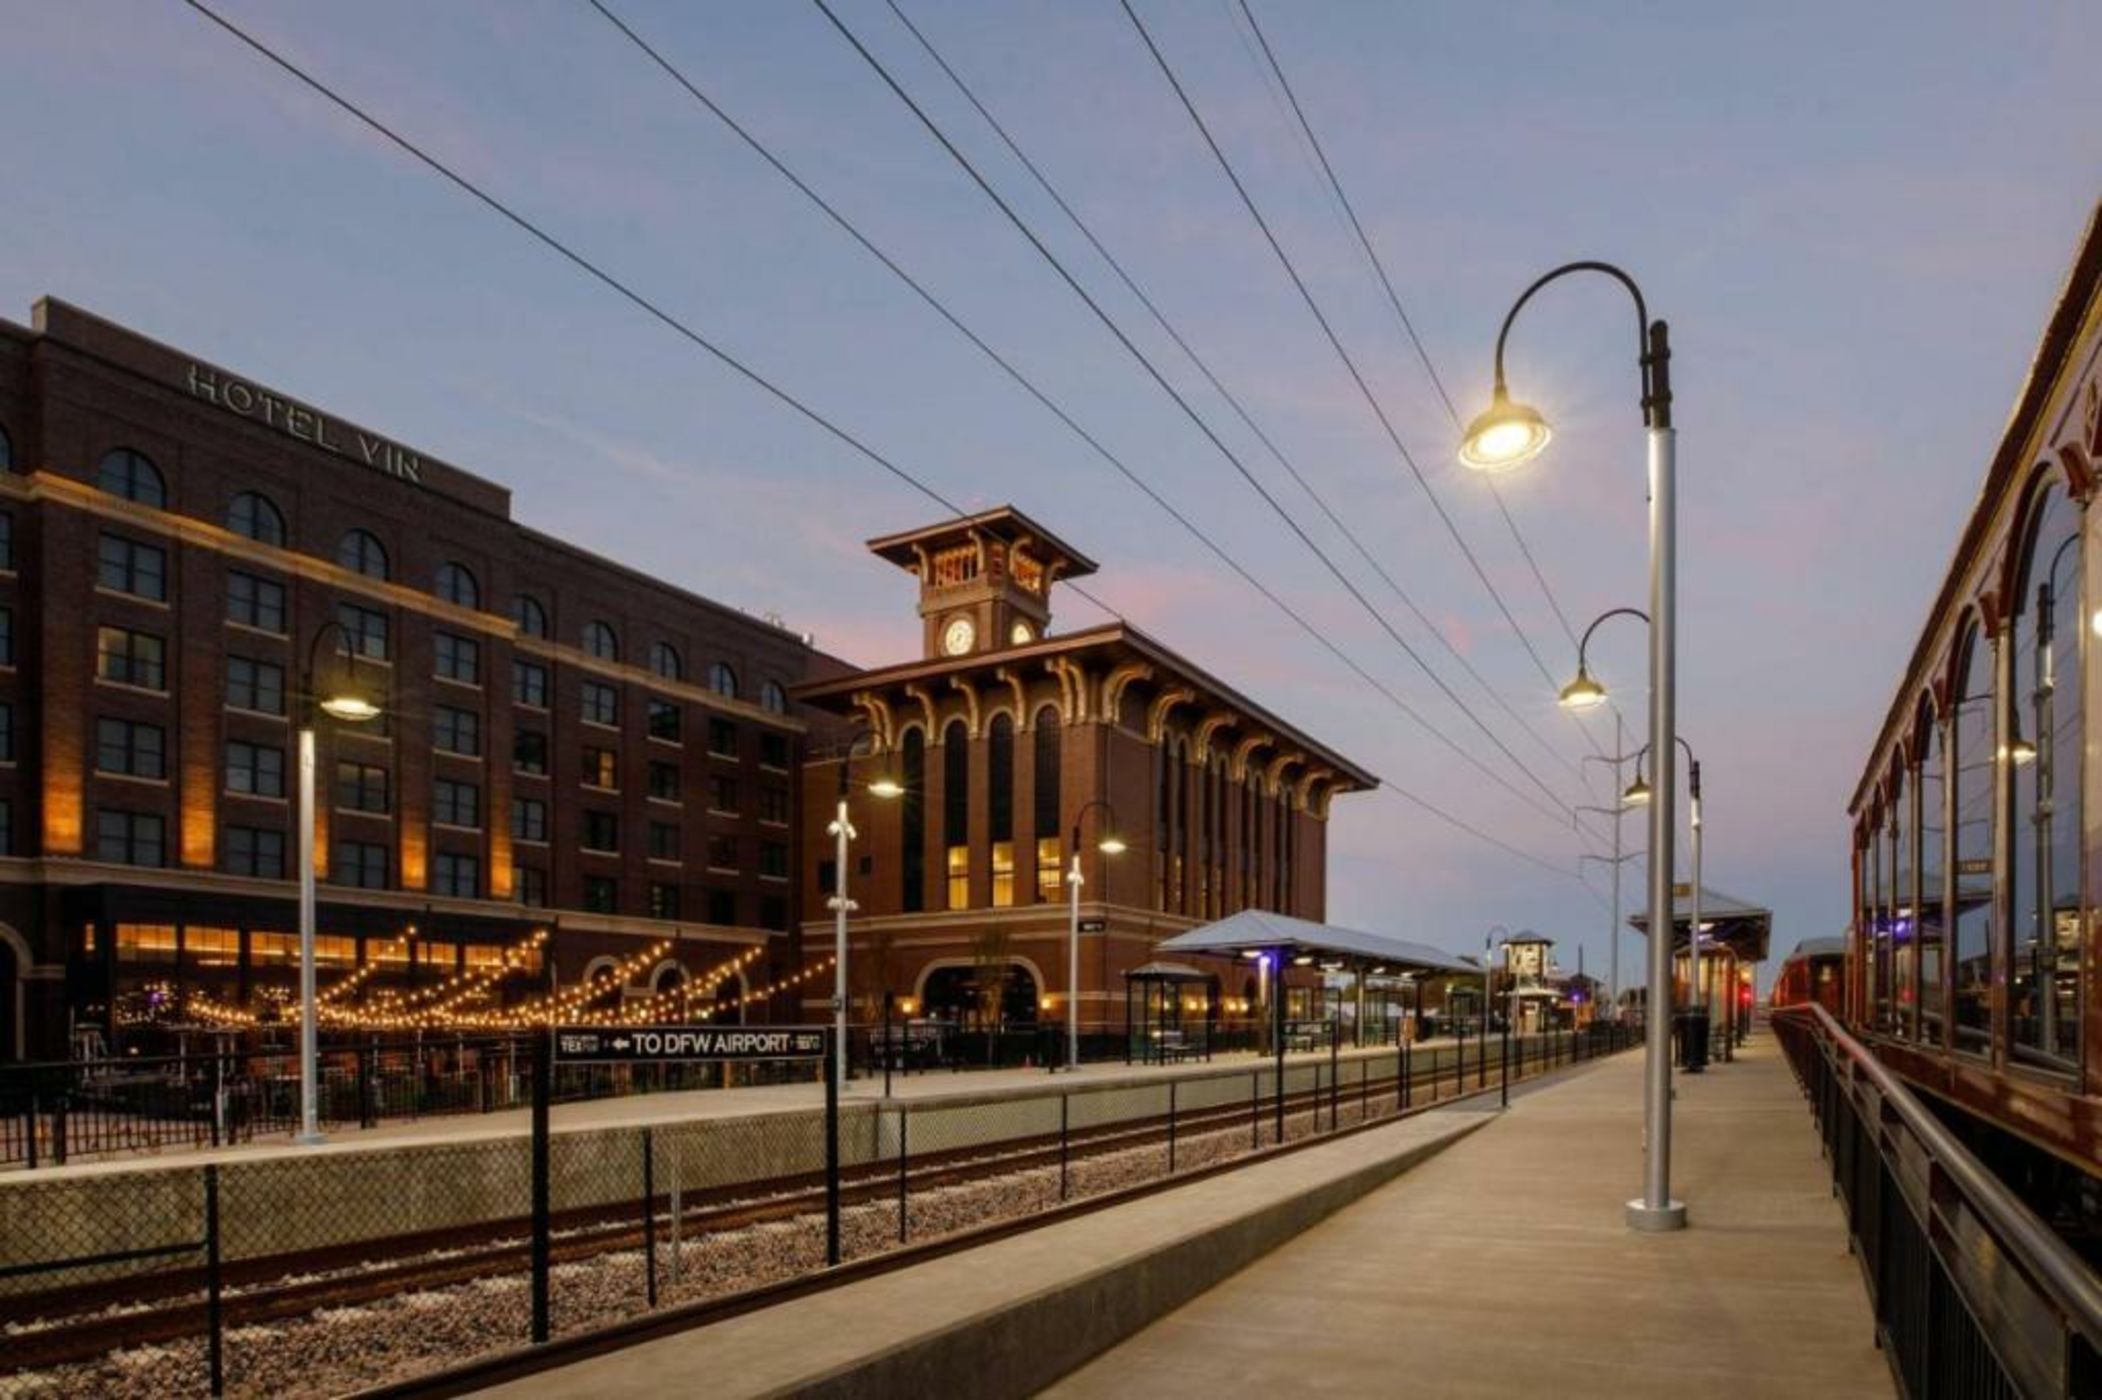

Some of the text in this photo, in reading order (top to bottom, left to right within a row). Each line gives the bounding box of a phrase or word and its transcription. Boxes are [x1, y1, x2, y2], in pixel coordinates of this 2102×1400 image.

[187, 363, 420, 483] HOTEL VIN
[632, 1033, 662, 1054] TO
[664, 1033, 711, 1054] DFW
[714, 1033, 790, 1053] AIRPORT
